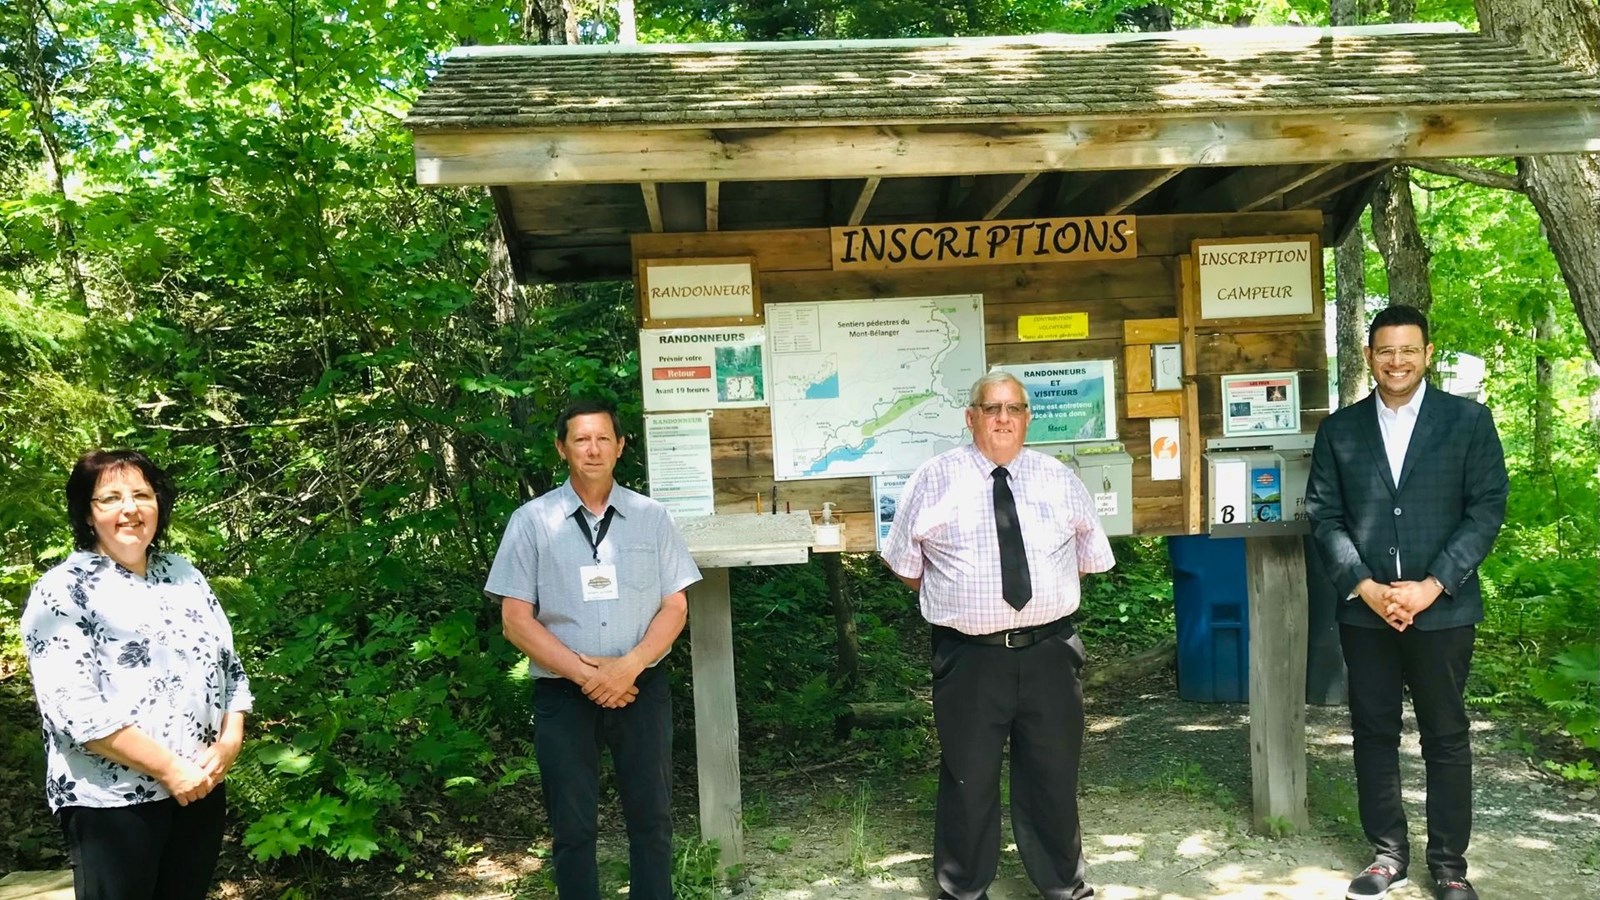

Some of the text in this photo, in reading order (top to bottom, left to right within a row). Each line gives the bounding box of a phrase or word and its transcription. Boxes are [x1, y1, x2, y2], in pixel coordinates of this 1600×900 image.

[840, 218, 1129, 263] INSCRIPTIONS
[1200, 248, 1308, 266] INSCRIPTION
[651, 284, 751, 299] RANDONNEUR
[1217, 285, 1293, 301] CAMPEUR
[866, 319, 899, 327] pédestres
[1033, 315, 1073, 323] CONTRIBUTION
[659, 332, 746, 344] RANDONNEURS
[849, 329, 900, 338] Mont-Bélanger
[658, 355, 684, 363] Prévoir
[667, 369, 696, 377] Retour
[1024, 367, 1087, 378] RANDONNEURS
[1050, 379, 1061, 387] ET
[1034, 388, 1078, 398] VISITEURS
[653, 417, 702, 425] RANDONNEUR
[1048, 424, 1067, 432] Merci
[1220, 505, 1235, 524] B
[1257, 504, 1271, 522] C
